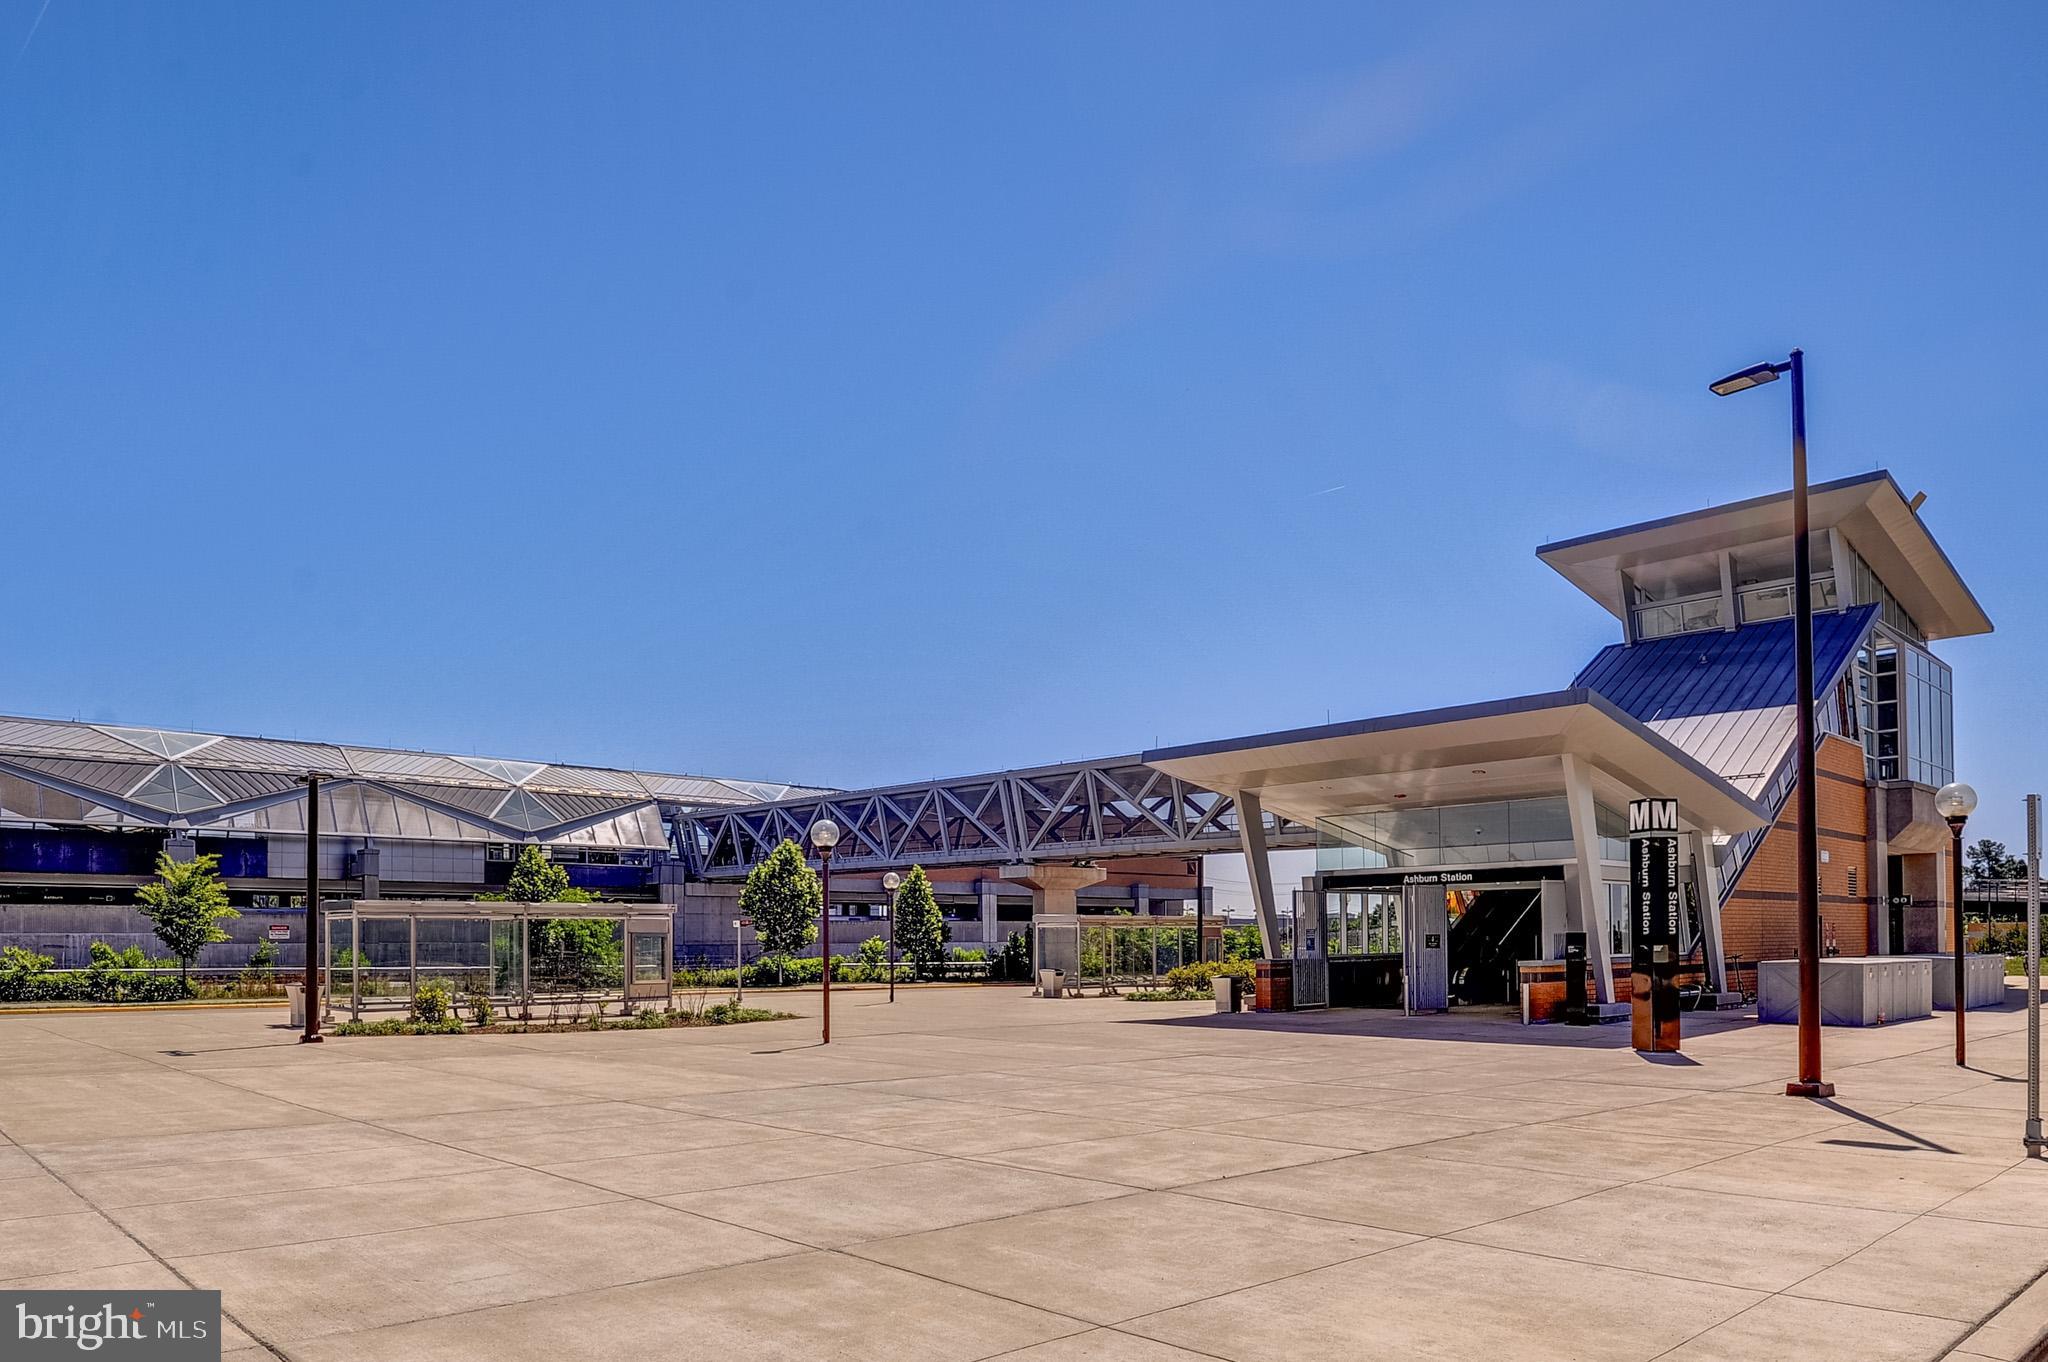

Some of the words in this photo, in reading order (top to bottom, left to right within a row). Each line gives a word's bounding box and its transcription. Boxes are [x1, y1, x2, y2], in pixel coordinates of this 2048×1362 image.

[1630, 803, 1649, 831] M
[1652, 802, 1677, 829] M
[1403, 875, 1438, 884] Ashburn
[1440, 873, 1473, 882] Station
[1641, 839, 1650, 887] Ashburn
[1667, 838, 1677, 887] Ashburn
[1642, 892, 1651, 935] Station
[1668, 892, 1678, 935] Station
